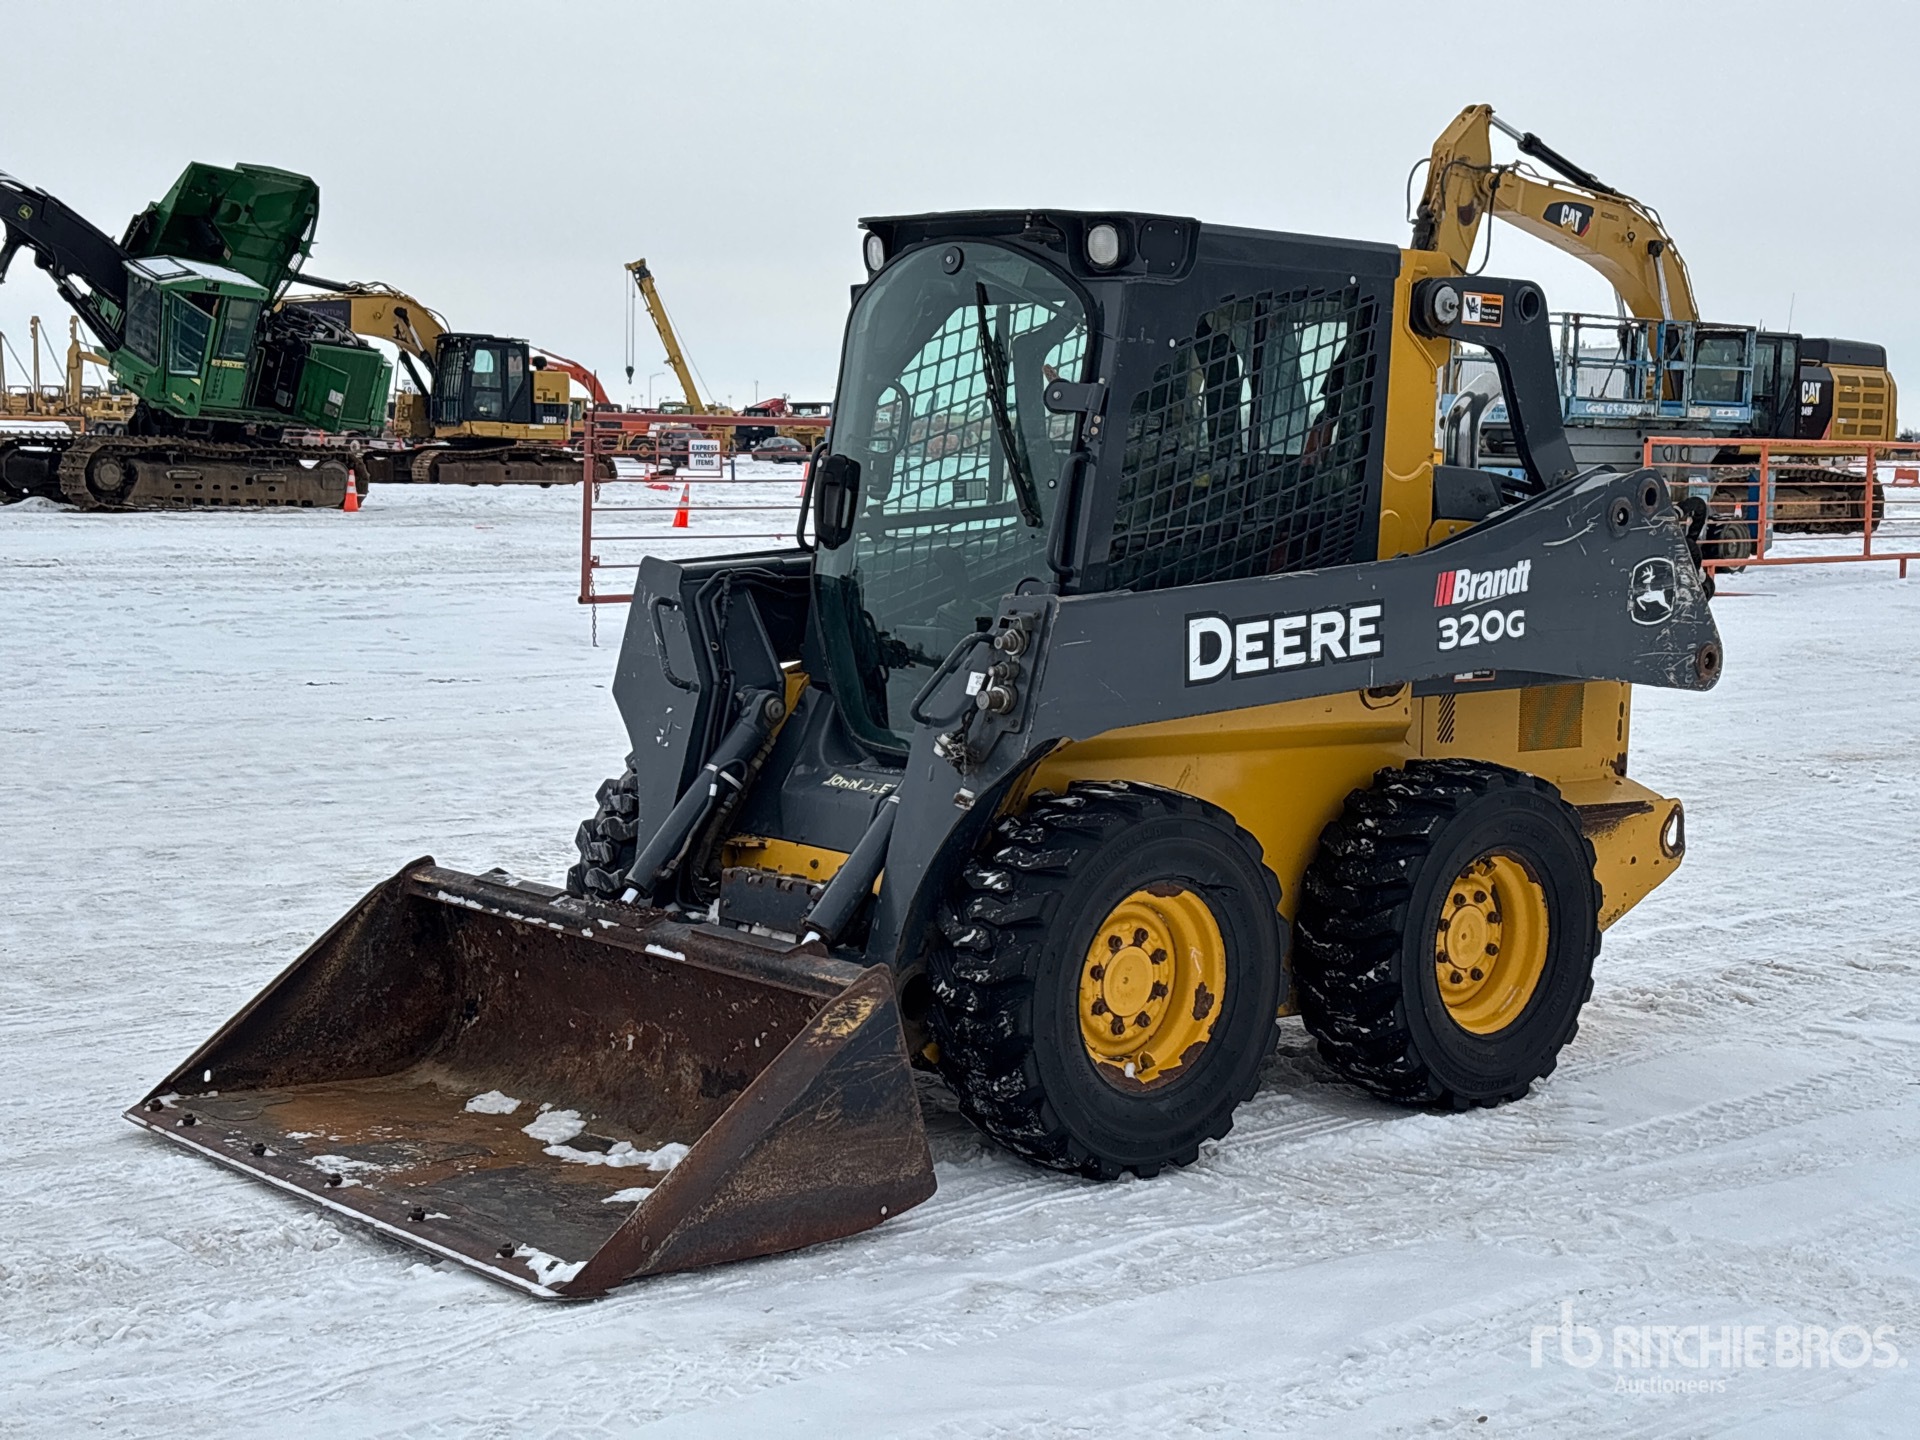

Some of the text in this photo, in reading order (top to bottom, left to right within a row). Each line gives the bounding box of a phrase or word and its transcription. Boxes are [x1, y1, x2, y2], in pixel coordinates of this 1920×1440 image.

[1560, 204, 1582, 232] CAT
[1801, 381, 1821, 405] CAT
[691, 443, 718, 451] EXPRESS
[1452, 559, 1531, 604] Brandt
[1189, 605, 1381, 681] DEERE
[1439, 610, 1525, 650] 320G
